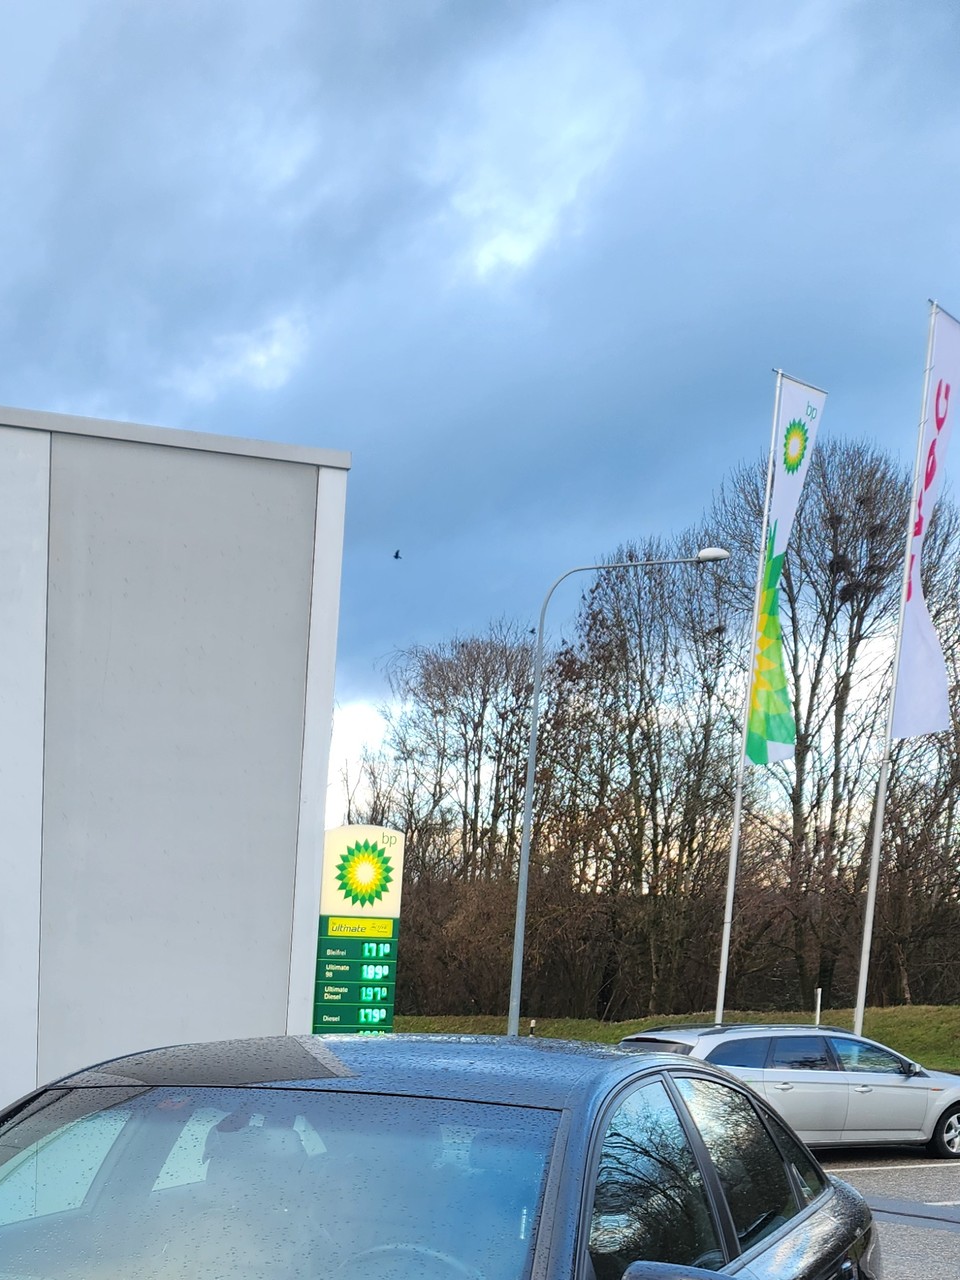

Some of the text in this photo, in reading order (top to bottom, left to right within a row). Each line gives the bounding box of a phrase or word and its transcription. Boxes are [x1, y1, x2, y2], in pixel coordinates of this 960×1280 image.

[805, 400, 818, 422] bp
[381, 832, 397, 847] bp
[331, 923, 367, 933] ultimate
